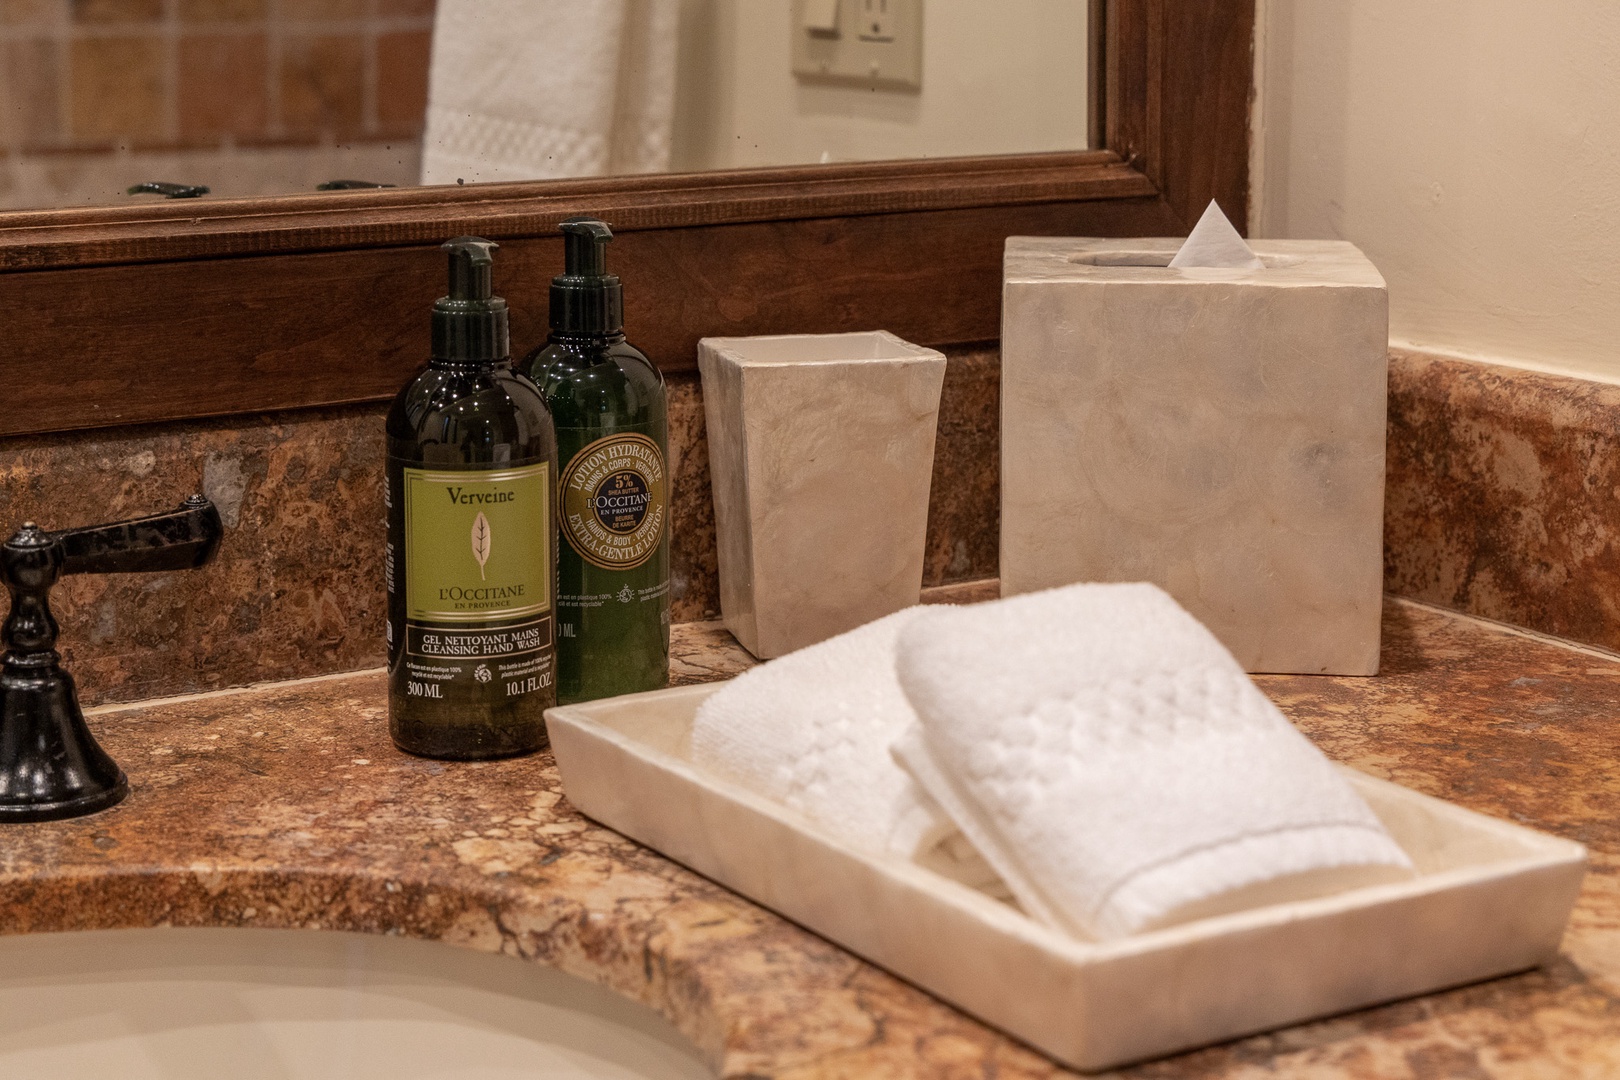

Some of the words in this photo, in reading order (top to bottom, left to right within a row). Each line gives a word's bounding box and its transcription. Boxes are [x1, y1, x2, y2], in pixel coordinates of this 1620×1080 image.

[569, 450, 608, 491] LOTION
[608, 444, 663, 482] HYDRATANTE
[584, 469, 603, 492] MAINS
[602, 465, 609, 474] &
[608, 458, 631, 471] CORPS
[635, 459, 655, 485] VERVEINE
[615, 473, 634, 489] 5%
[446, 486, 515, 505] Verveine
[611, 505, 644, 515] PROVENCE
[569, 513, 644, 560] EXTRA-GENTLE
[643, 504, 663, 548] LOTION
[586, 518, 606, 541] HANDS
[606, 534, 612, 544] &
[613, 536, 632, 547] BODY
[635, 512, 655, 540] VERBENA
[439, 584, 525, 601] L'OCCITANE
[468, 600, 511, 609] PROVENCE
[421, 644, 479, 655] CLEANSING
[483, 642, 514, 654] HAND
[517, 637, 540, 650] WASH
[423, 634, 442, 645] GEL
[445, 634, 508, 646] NETTOYANT
[511, 628, 539, 642] MAINS
[407, 681, 423, 696] 300
[424, 683, 443, 699] ML
[506, 680, 526, 696] 10.1
